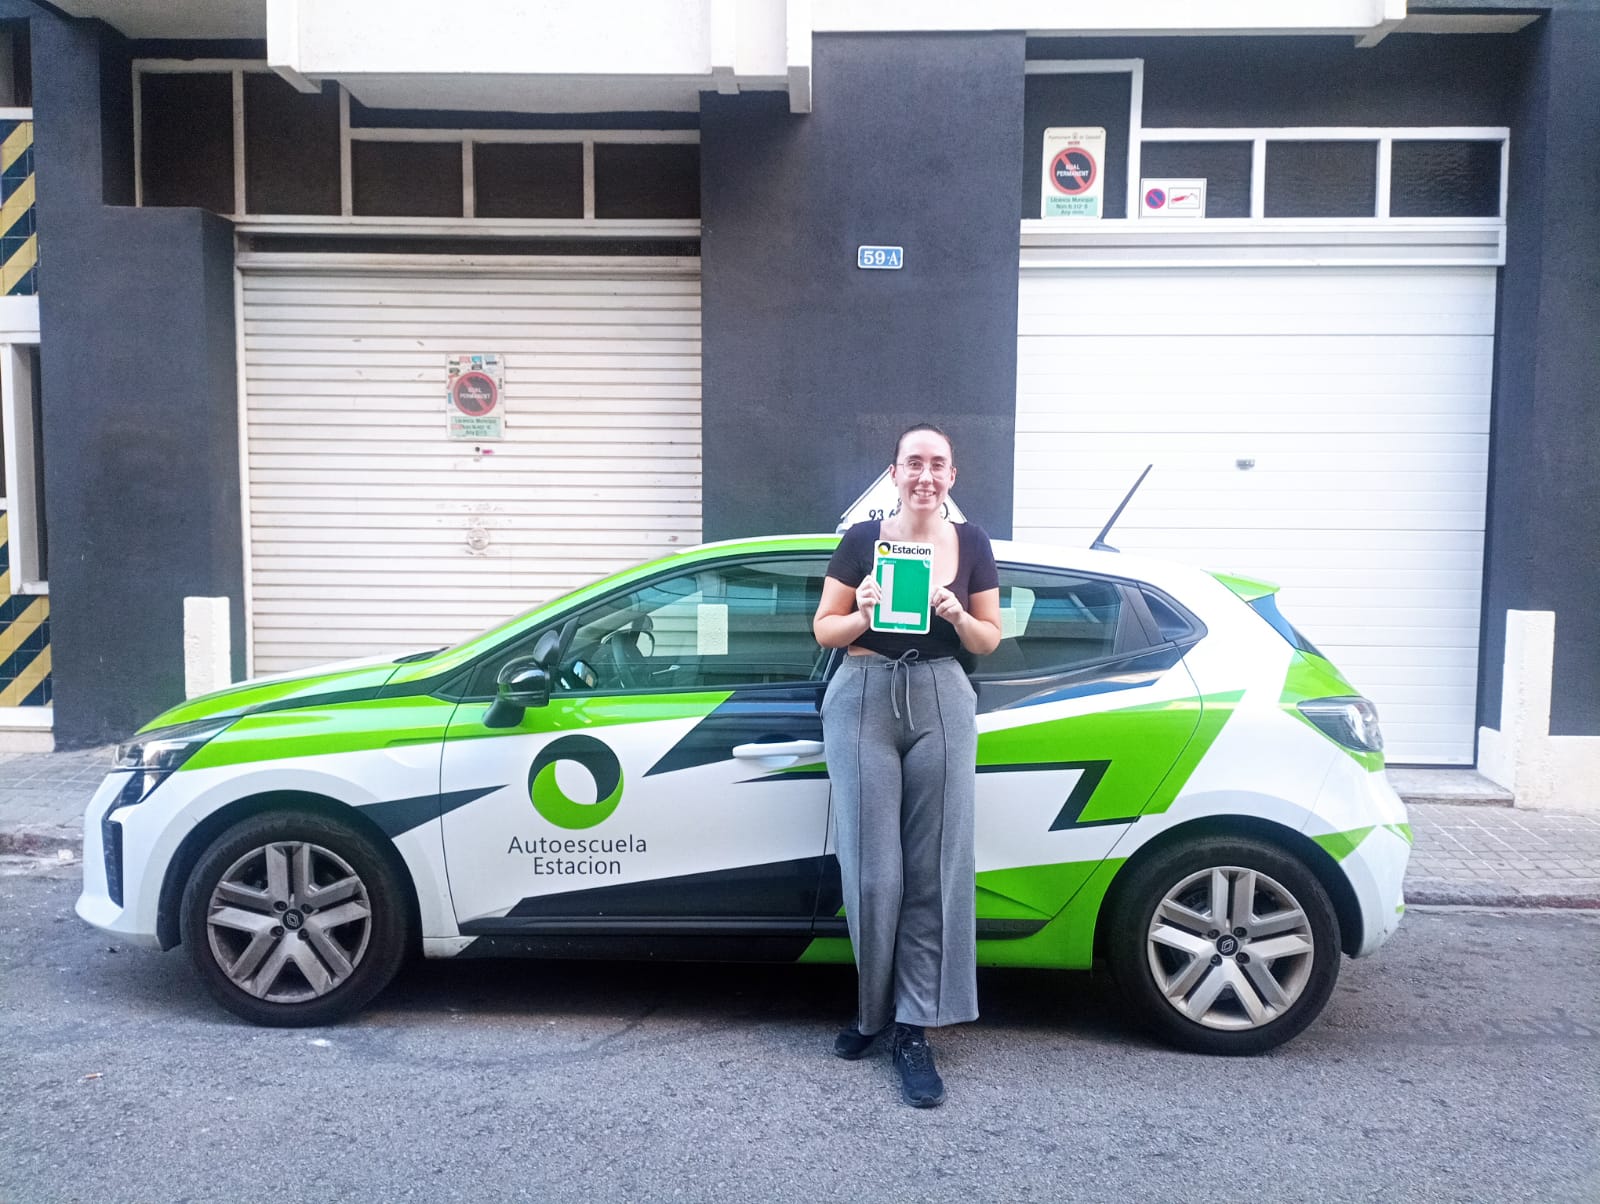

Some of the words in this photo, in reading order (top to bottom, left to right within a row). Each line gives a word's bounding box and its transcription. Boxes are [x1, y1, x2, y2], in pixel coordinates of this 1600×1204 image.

[892, 544, 931, 556] Estacion
[879, 563, 921, 626] L
[507, 833, 647, 854] Autoescuela
[534, 856, 621, 875] Estacion
